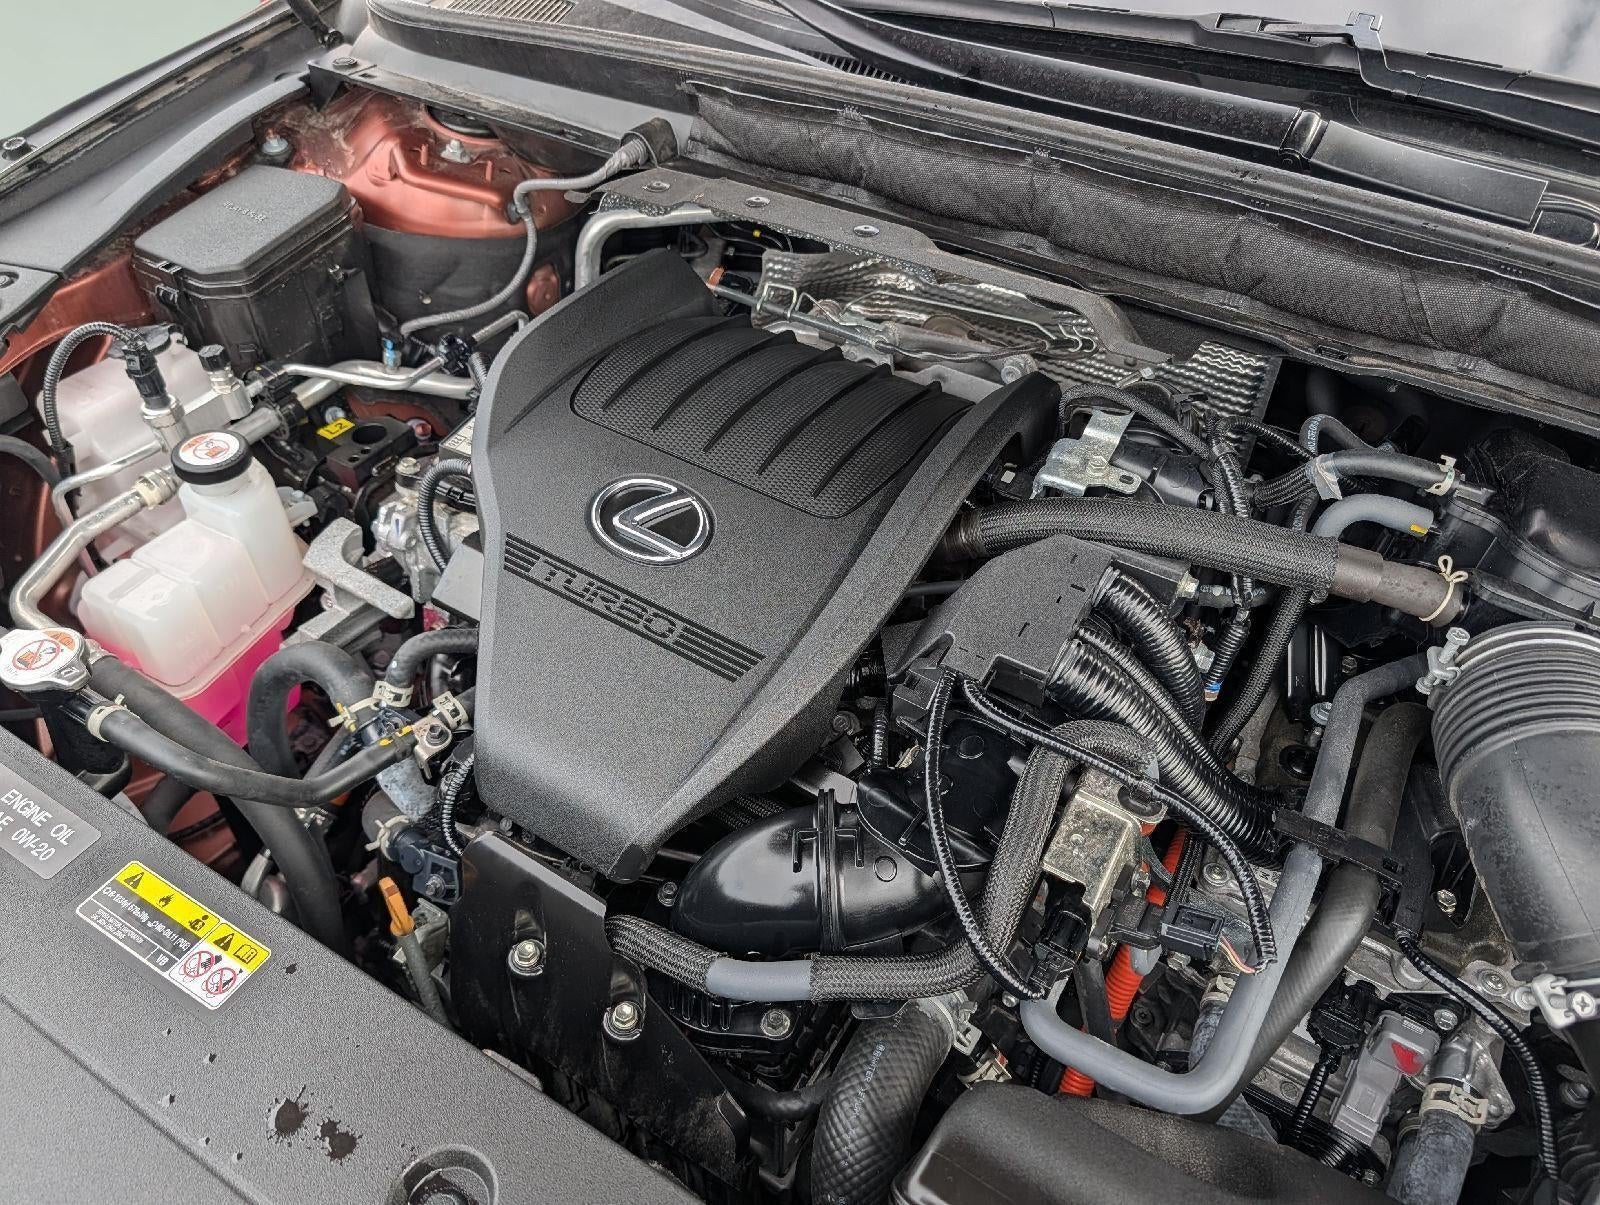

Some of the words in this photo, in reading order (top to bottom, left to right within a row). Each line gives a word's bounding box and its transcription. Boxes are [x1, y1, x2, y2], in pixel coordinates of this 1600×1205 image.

[324, 422, 343, 434] L2
[529, 554, 682, 641] TURBO
[1, 788, 53, 828] ENGINE
[50, 823, 76, 846] OIL
[11, 827, 56, 861] 0W-20
